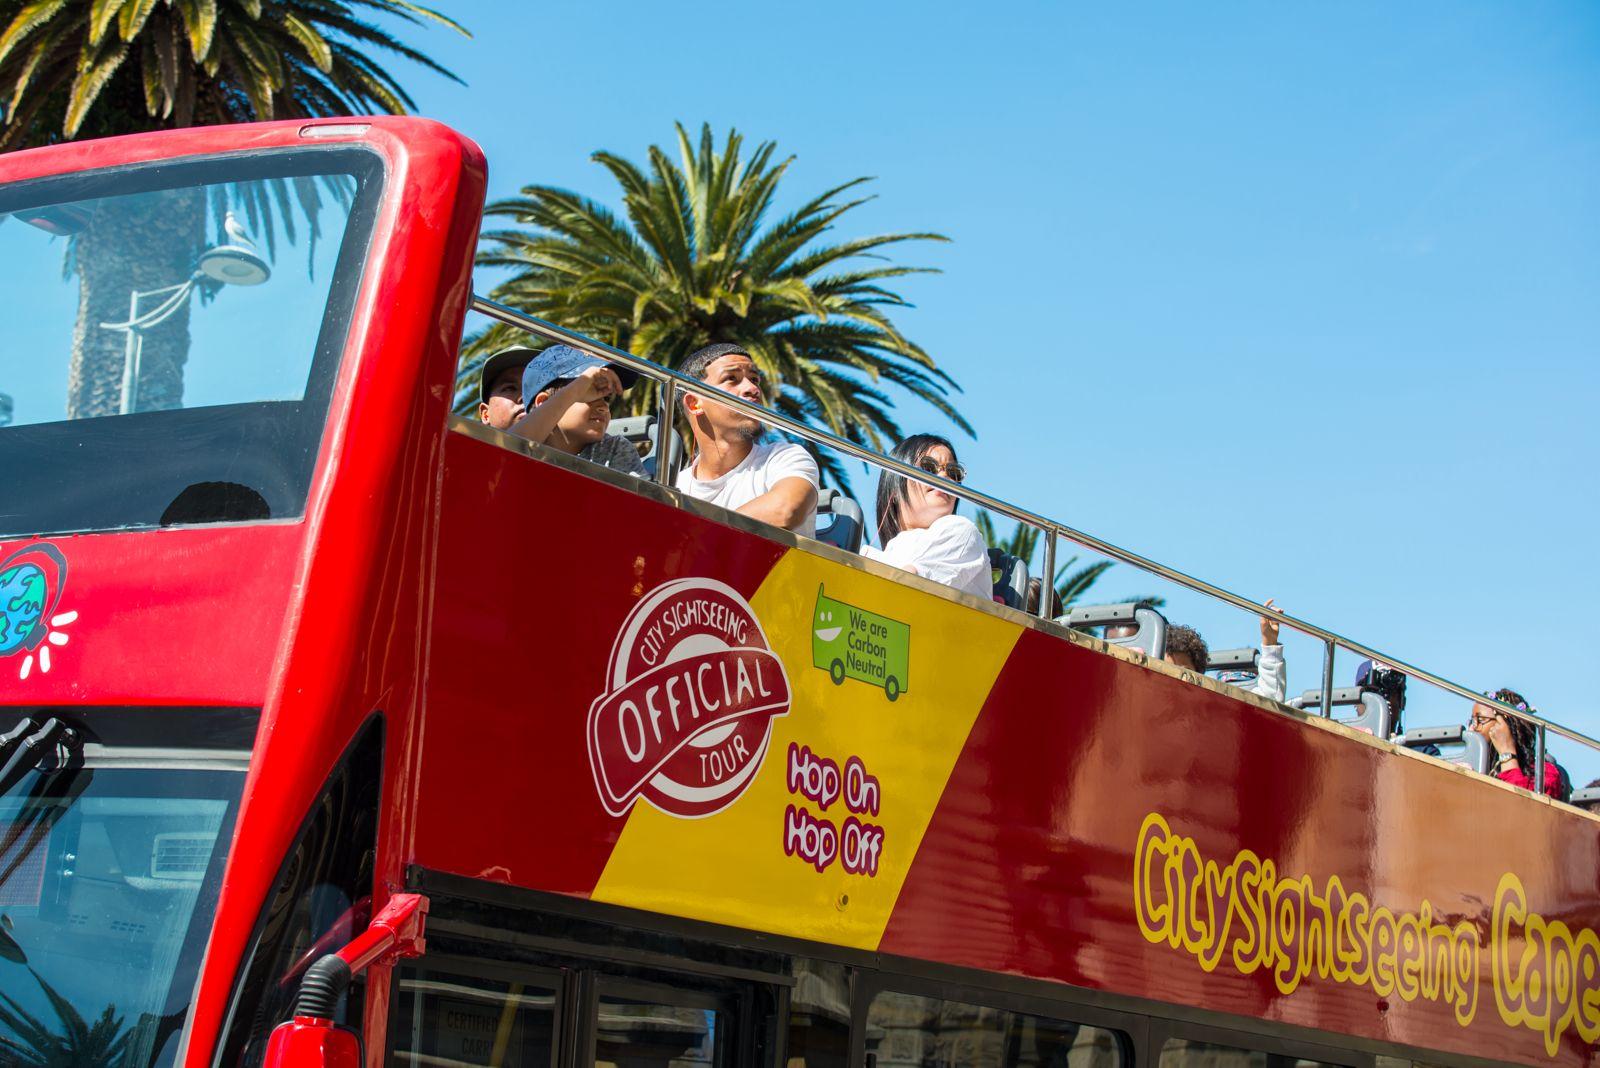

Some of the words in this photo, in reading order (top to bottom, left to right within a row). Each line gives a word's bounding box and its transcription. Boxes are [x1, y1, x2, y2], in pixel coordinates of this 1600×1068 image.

[640, 620, 665, 665] CITY
[663, 599, 748, 645] SIGHTSEEING
[847, 630, 887, 658] Carbon
[849, 610, 867, 632] We
[870, 623, 888, 639] are
[845, 652, 886, 680] Neutral
[618, 656, 772, 763] OFFICIAL
[699, 734, 750, 783] TOUR
[788, 746, 839, 807] Hop
[845, 760, 879, 813] On
[785, 808, 838, 869] Hop
[843, 820, 884, 872] Off
[1134, 812, 1480, 1027] CitySightseeing
[1492, 872, 1600, 1057] Cape
